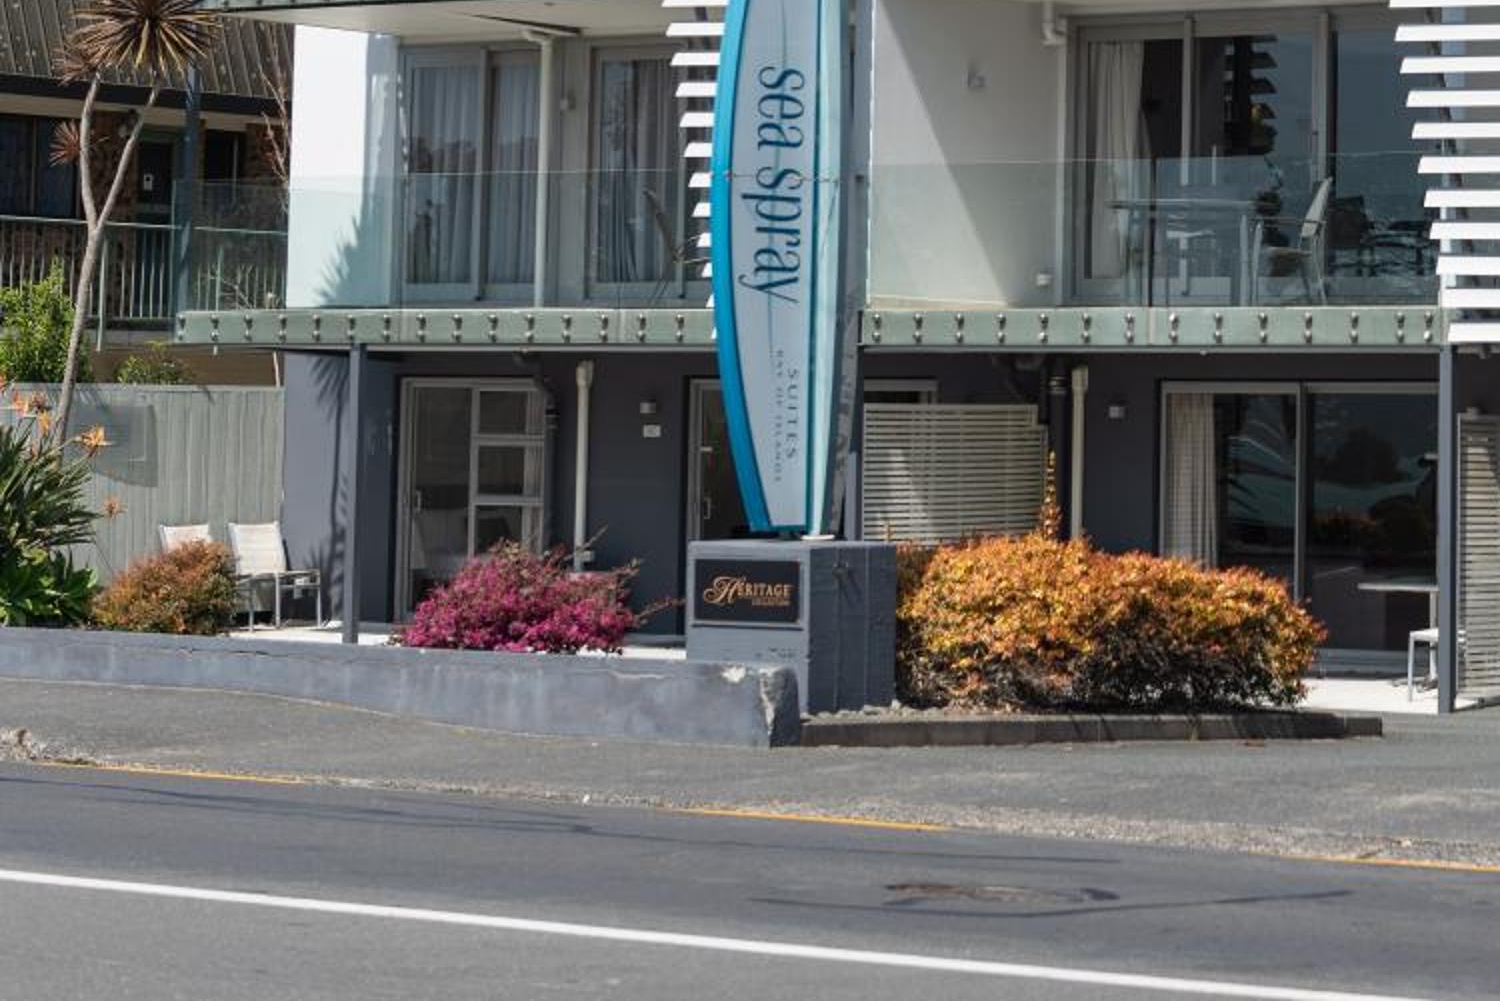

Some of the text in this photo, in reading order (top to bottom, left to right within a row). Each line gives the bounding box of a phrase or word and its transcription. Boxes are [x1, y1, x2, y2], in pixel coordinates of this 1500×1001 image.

[738, 66, 805, 304] sea spray
[785, 368, 798, 459] SUITES
[704, 576, 793, 605] HERITAGE
